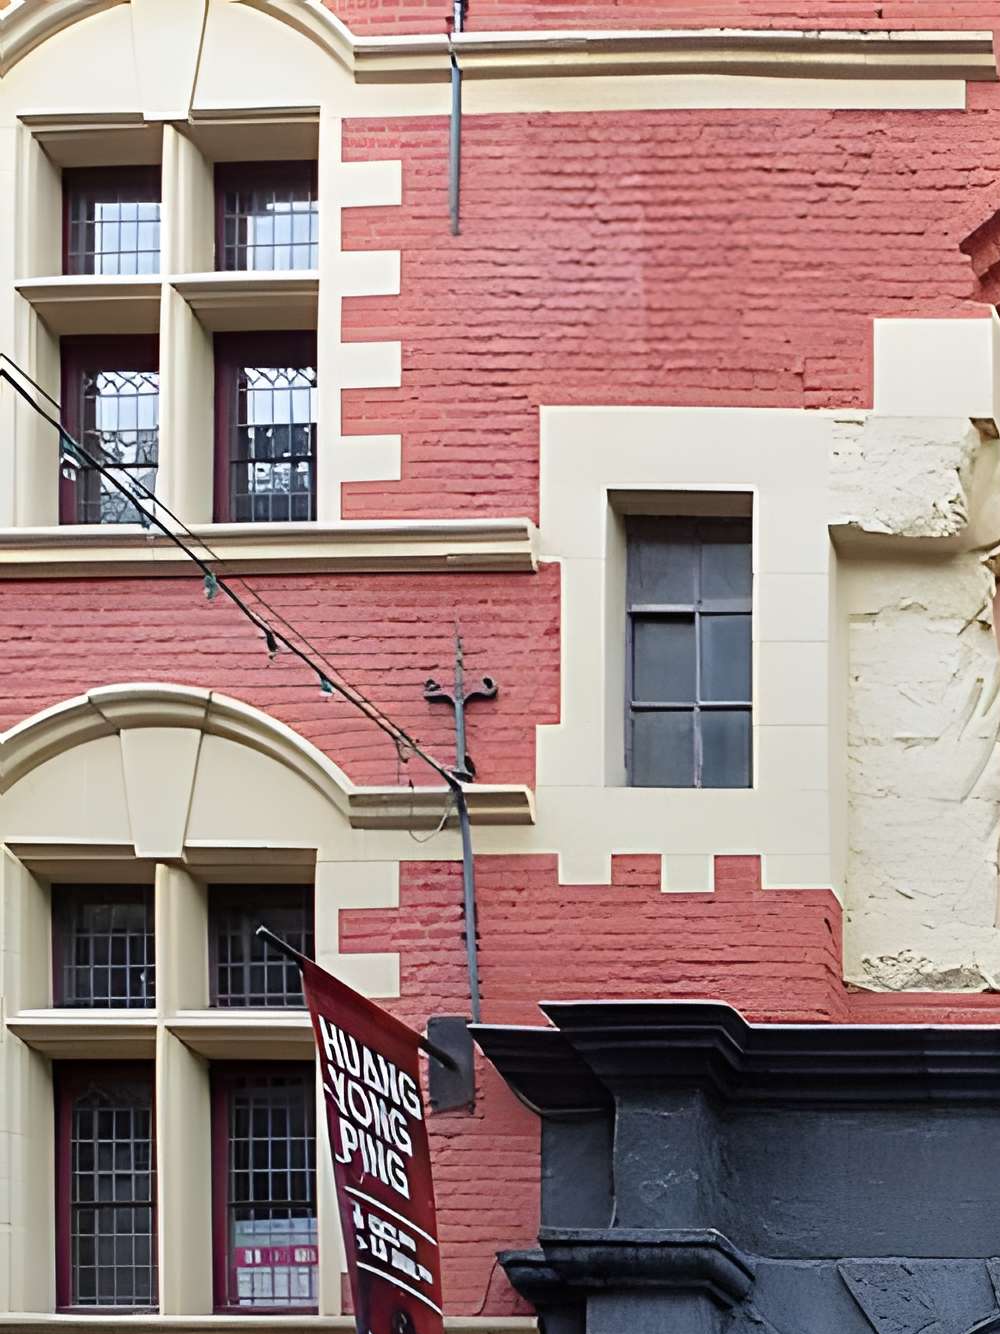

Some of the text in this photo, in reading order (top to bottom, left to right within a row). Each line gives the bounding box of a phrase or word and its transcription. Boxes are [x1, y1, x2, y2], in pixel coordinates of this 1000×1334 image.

[318, 1014, 422, 1120] HUANG
[323, 1064, 413, 1157] YONG
[336, 1117, 410, 1200] PING
